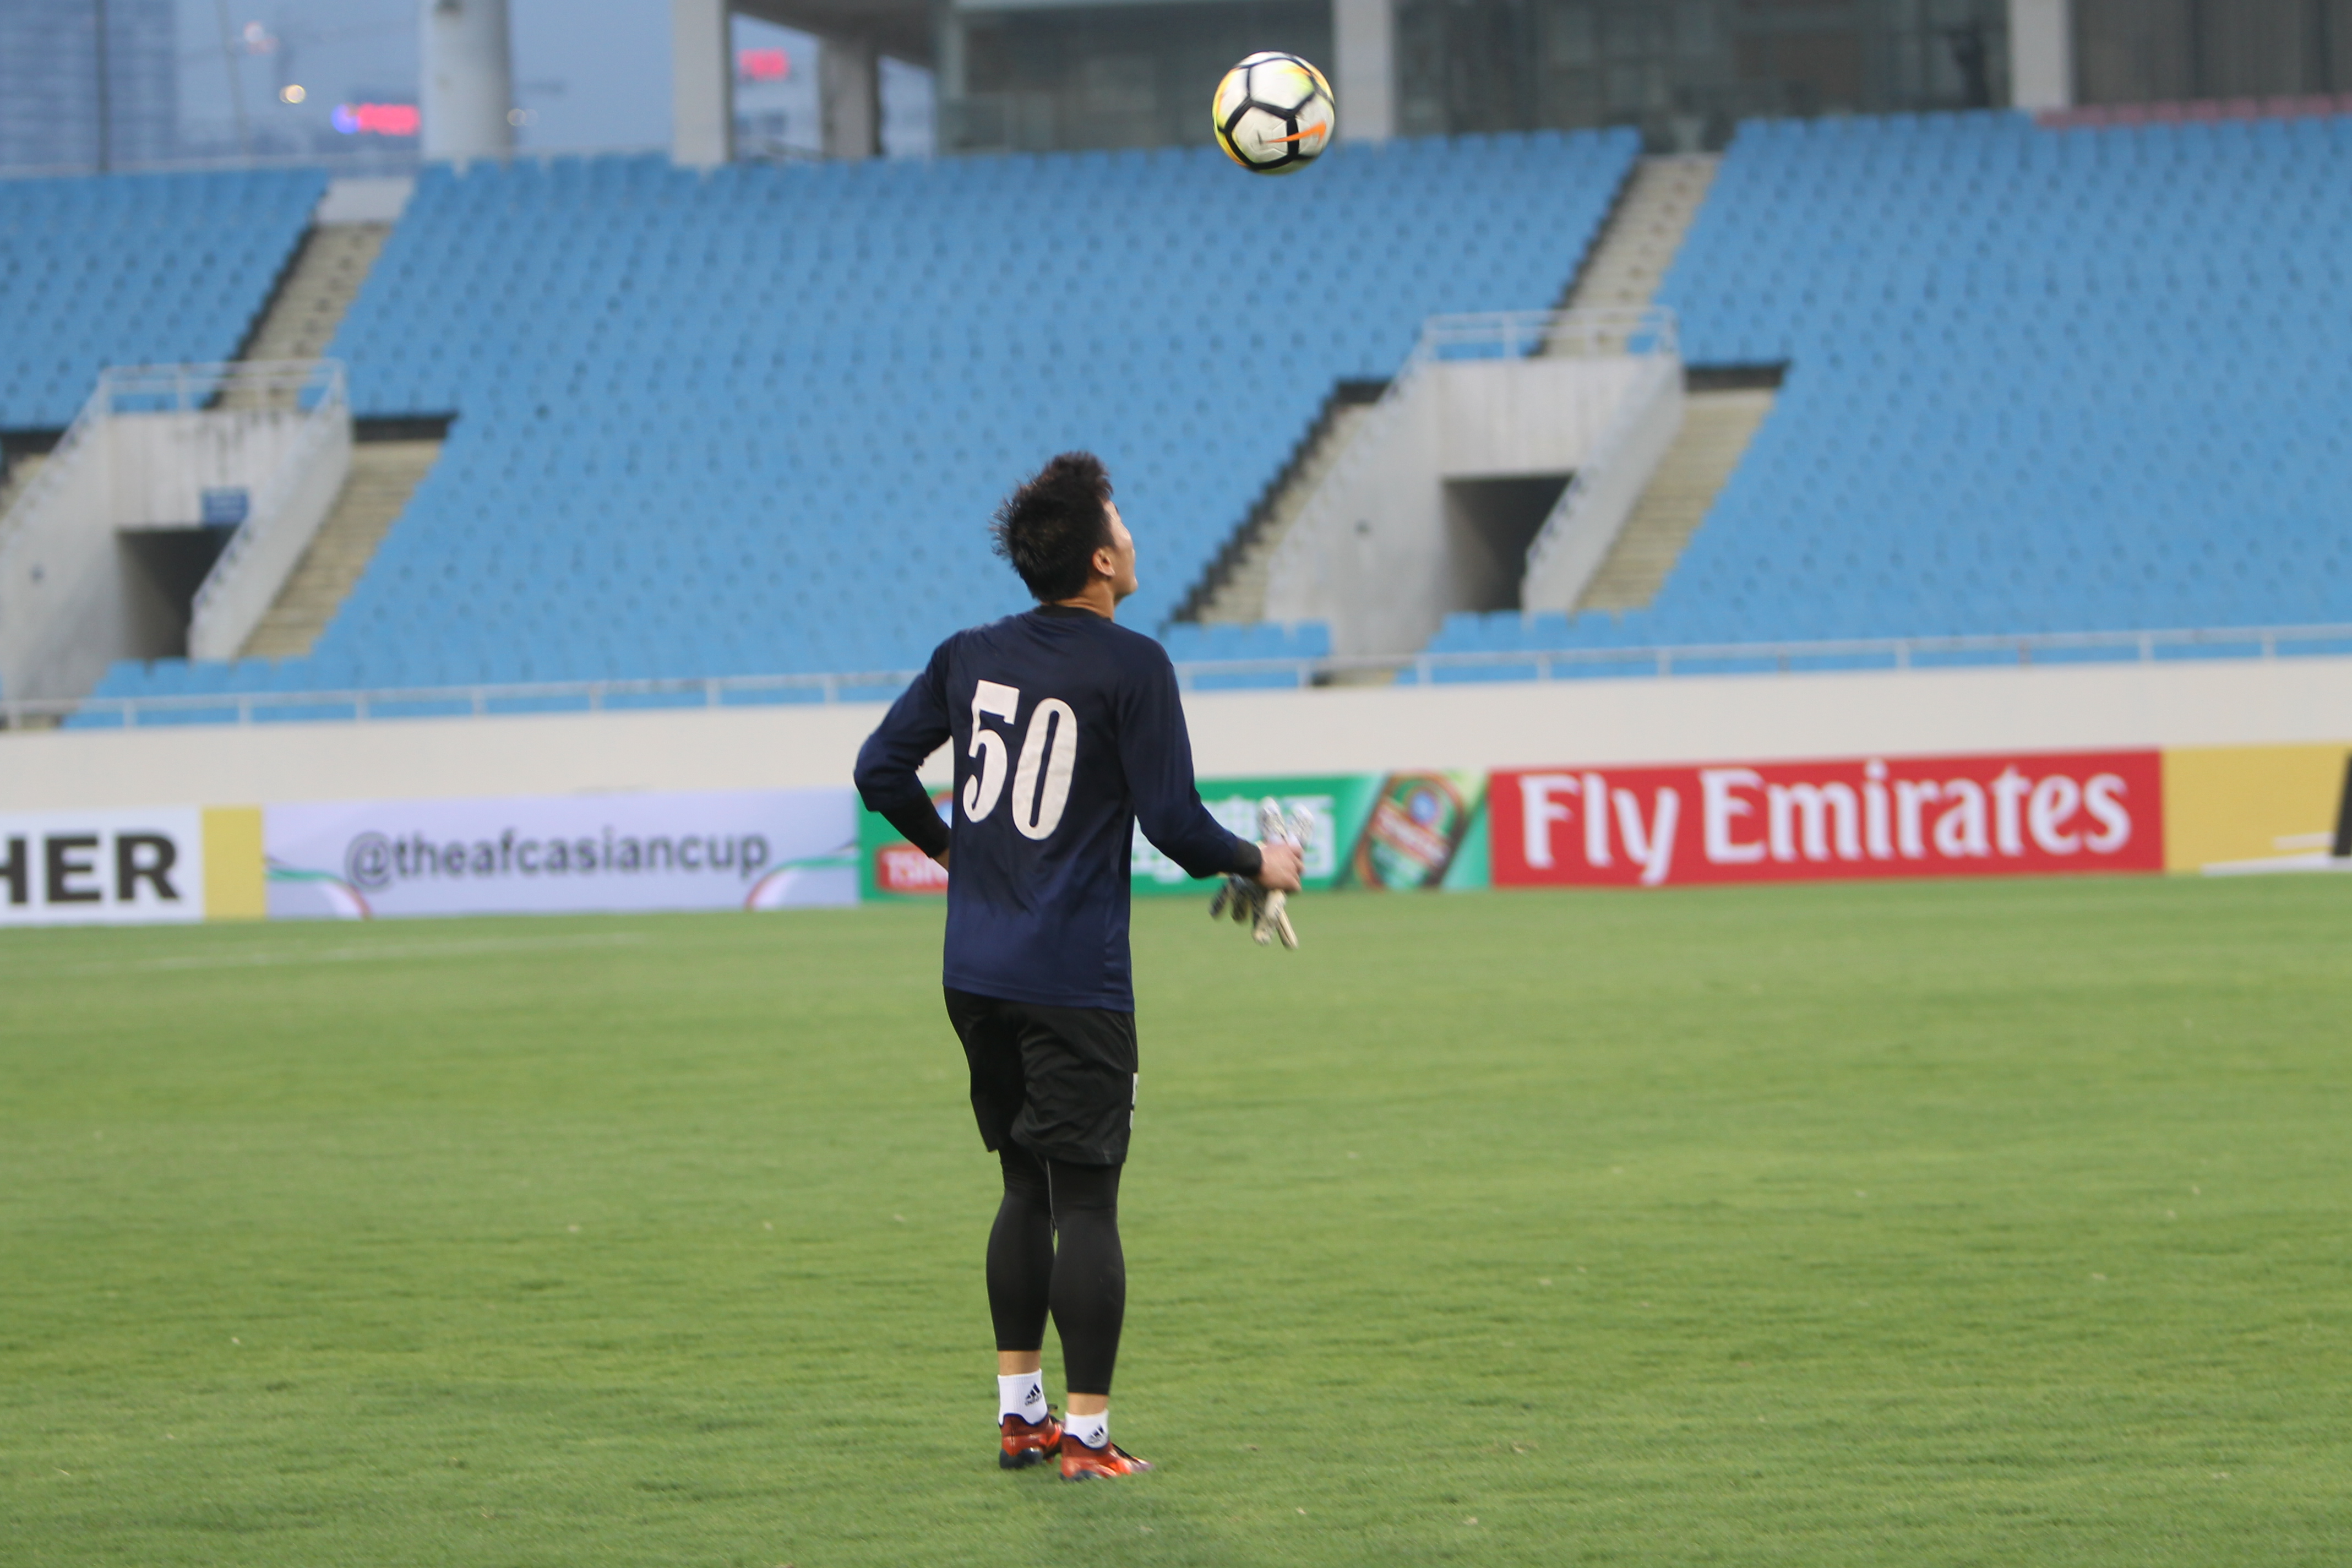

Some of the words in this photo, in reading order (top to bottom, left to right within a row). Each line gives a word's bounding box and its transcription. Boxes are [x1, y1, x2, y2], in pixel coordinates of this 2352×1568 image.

[962, 679, 1077, 841] 50
[1518, 772, 1680, 886] Fly
[1698, 758, 2132, 863] Emirates
[346, 826, 771, 891] @theafcasiancup
